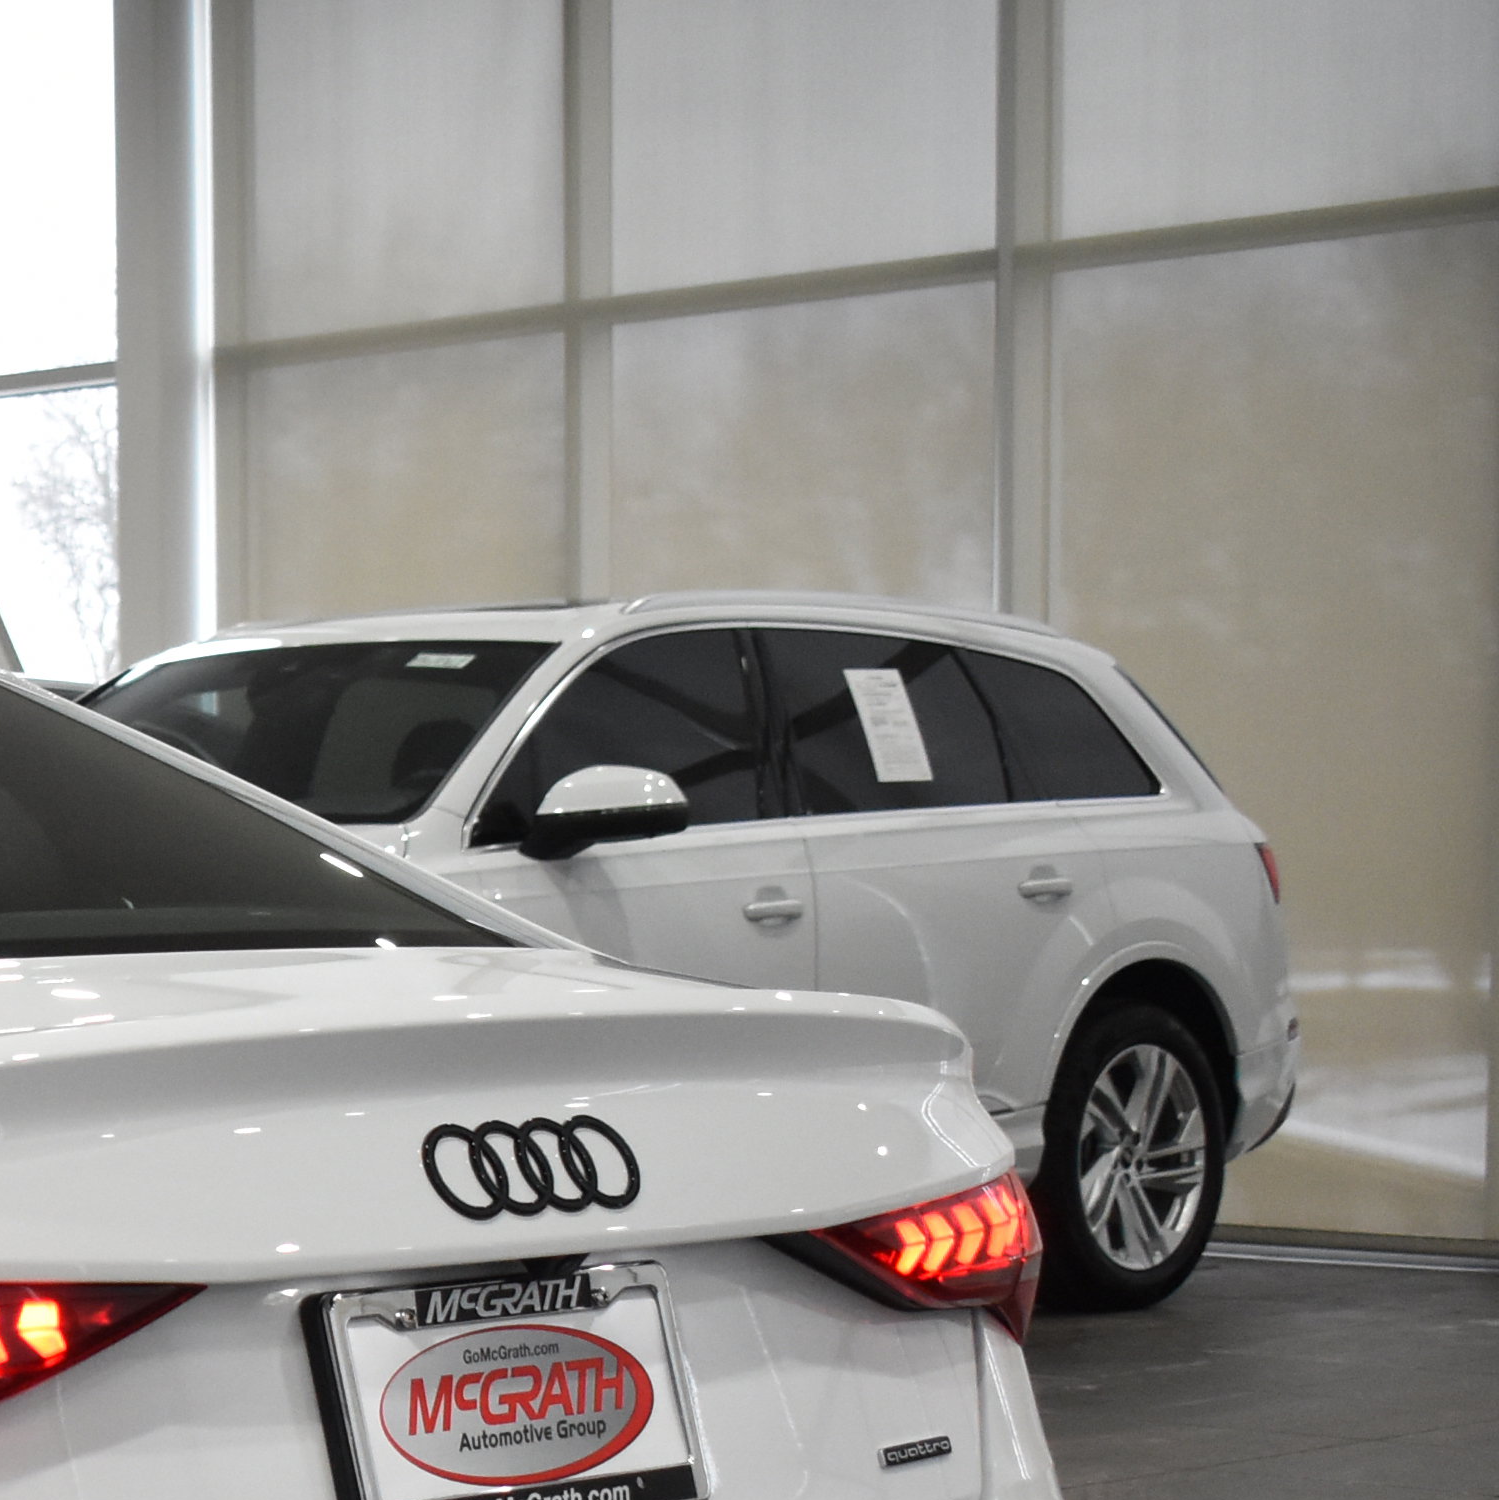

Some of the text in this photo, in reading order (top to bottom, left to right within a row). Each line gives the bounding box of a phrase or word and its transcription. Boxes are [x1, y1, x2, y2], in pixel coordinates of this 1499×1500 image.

[463, 1343, 559, 1365] GoMcGrath.com
[459, 1419, 607, 1453] Automotive Group
[887, 1440, 950, 1462] quattro
